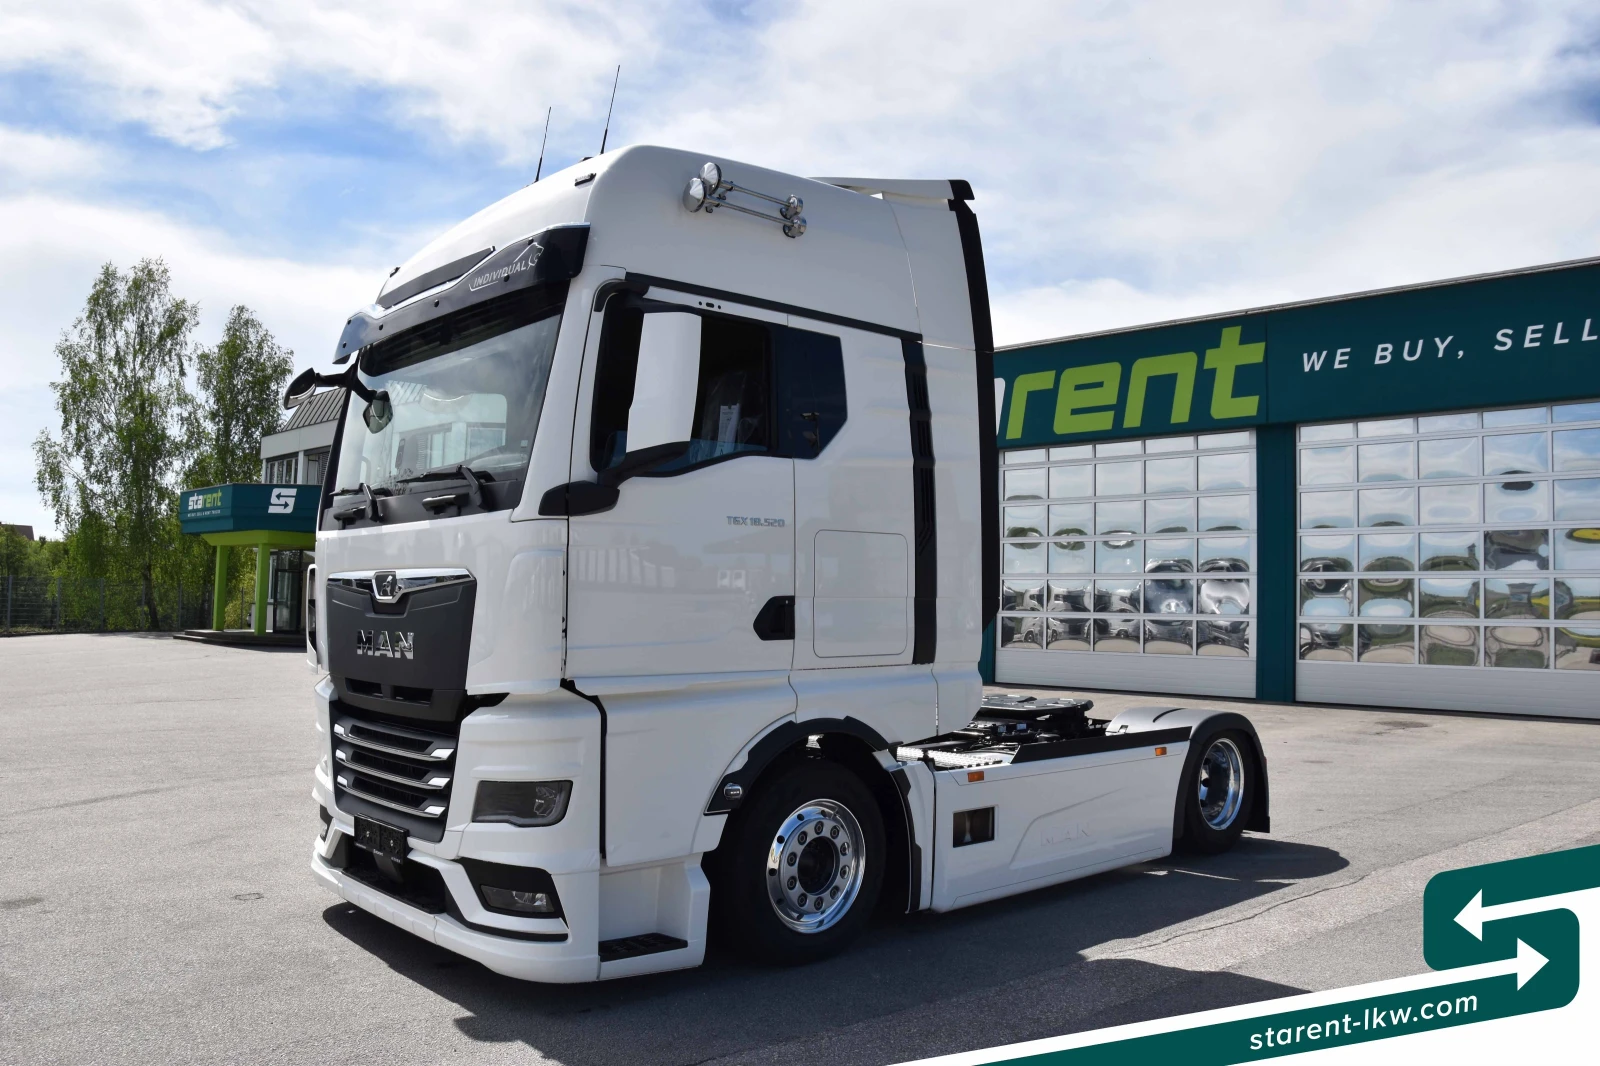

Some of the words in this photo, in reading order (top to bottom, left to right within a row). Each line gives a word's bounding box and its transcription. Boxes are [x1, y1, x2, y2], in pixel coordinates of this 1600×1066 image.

[473, 260, 527, 288] INDIVIDUAL
[1302, 347, 1351, 373] WE
[1374, 335, 1464, 365] BUY,
[1493, 318, 1598, 351] SELL
[188, 489, 222, 511] starent
[726, 515, 749, 526] TGX
[749, 517, 786, 528] 18.520
[356, 629, 414, 660] MAN
